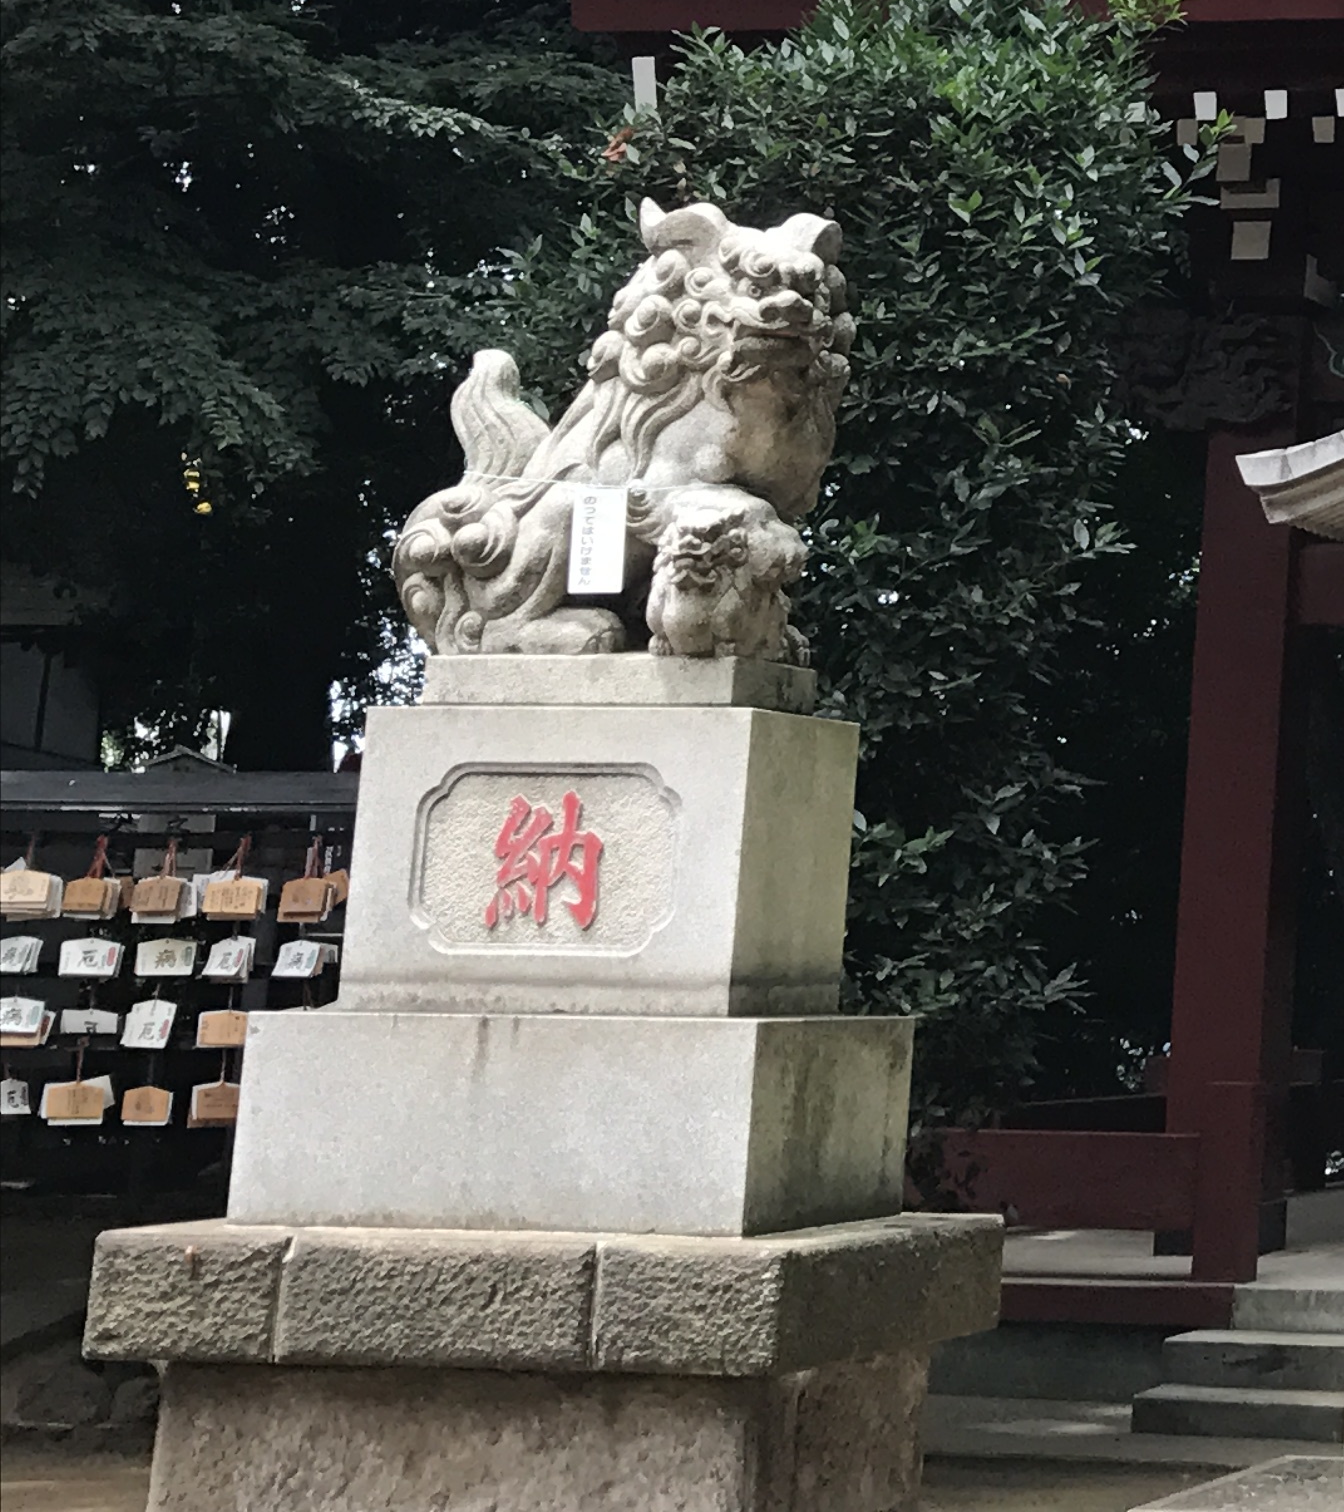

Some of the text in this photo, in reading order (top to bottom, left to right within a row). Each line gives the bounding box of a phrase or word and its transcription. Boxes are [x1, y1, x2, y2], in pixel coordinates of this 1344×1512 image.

[578, 496, 598, 586] のってはいけません
[485, 789, 604, 931] 納
